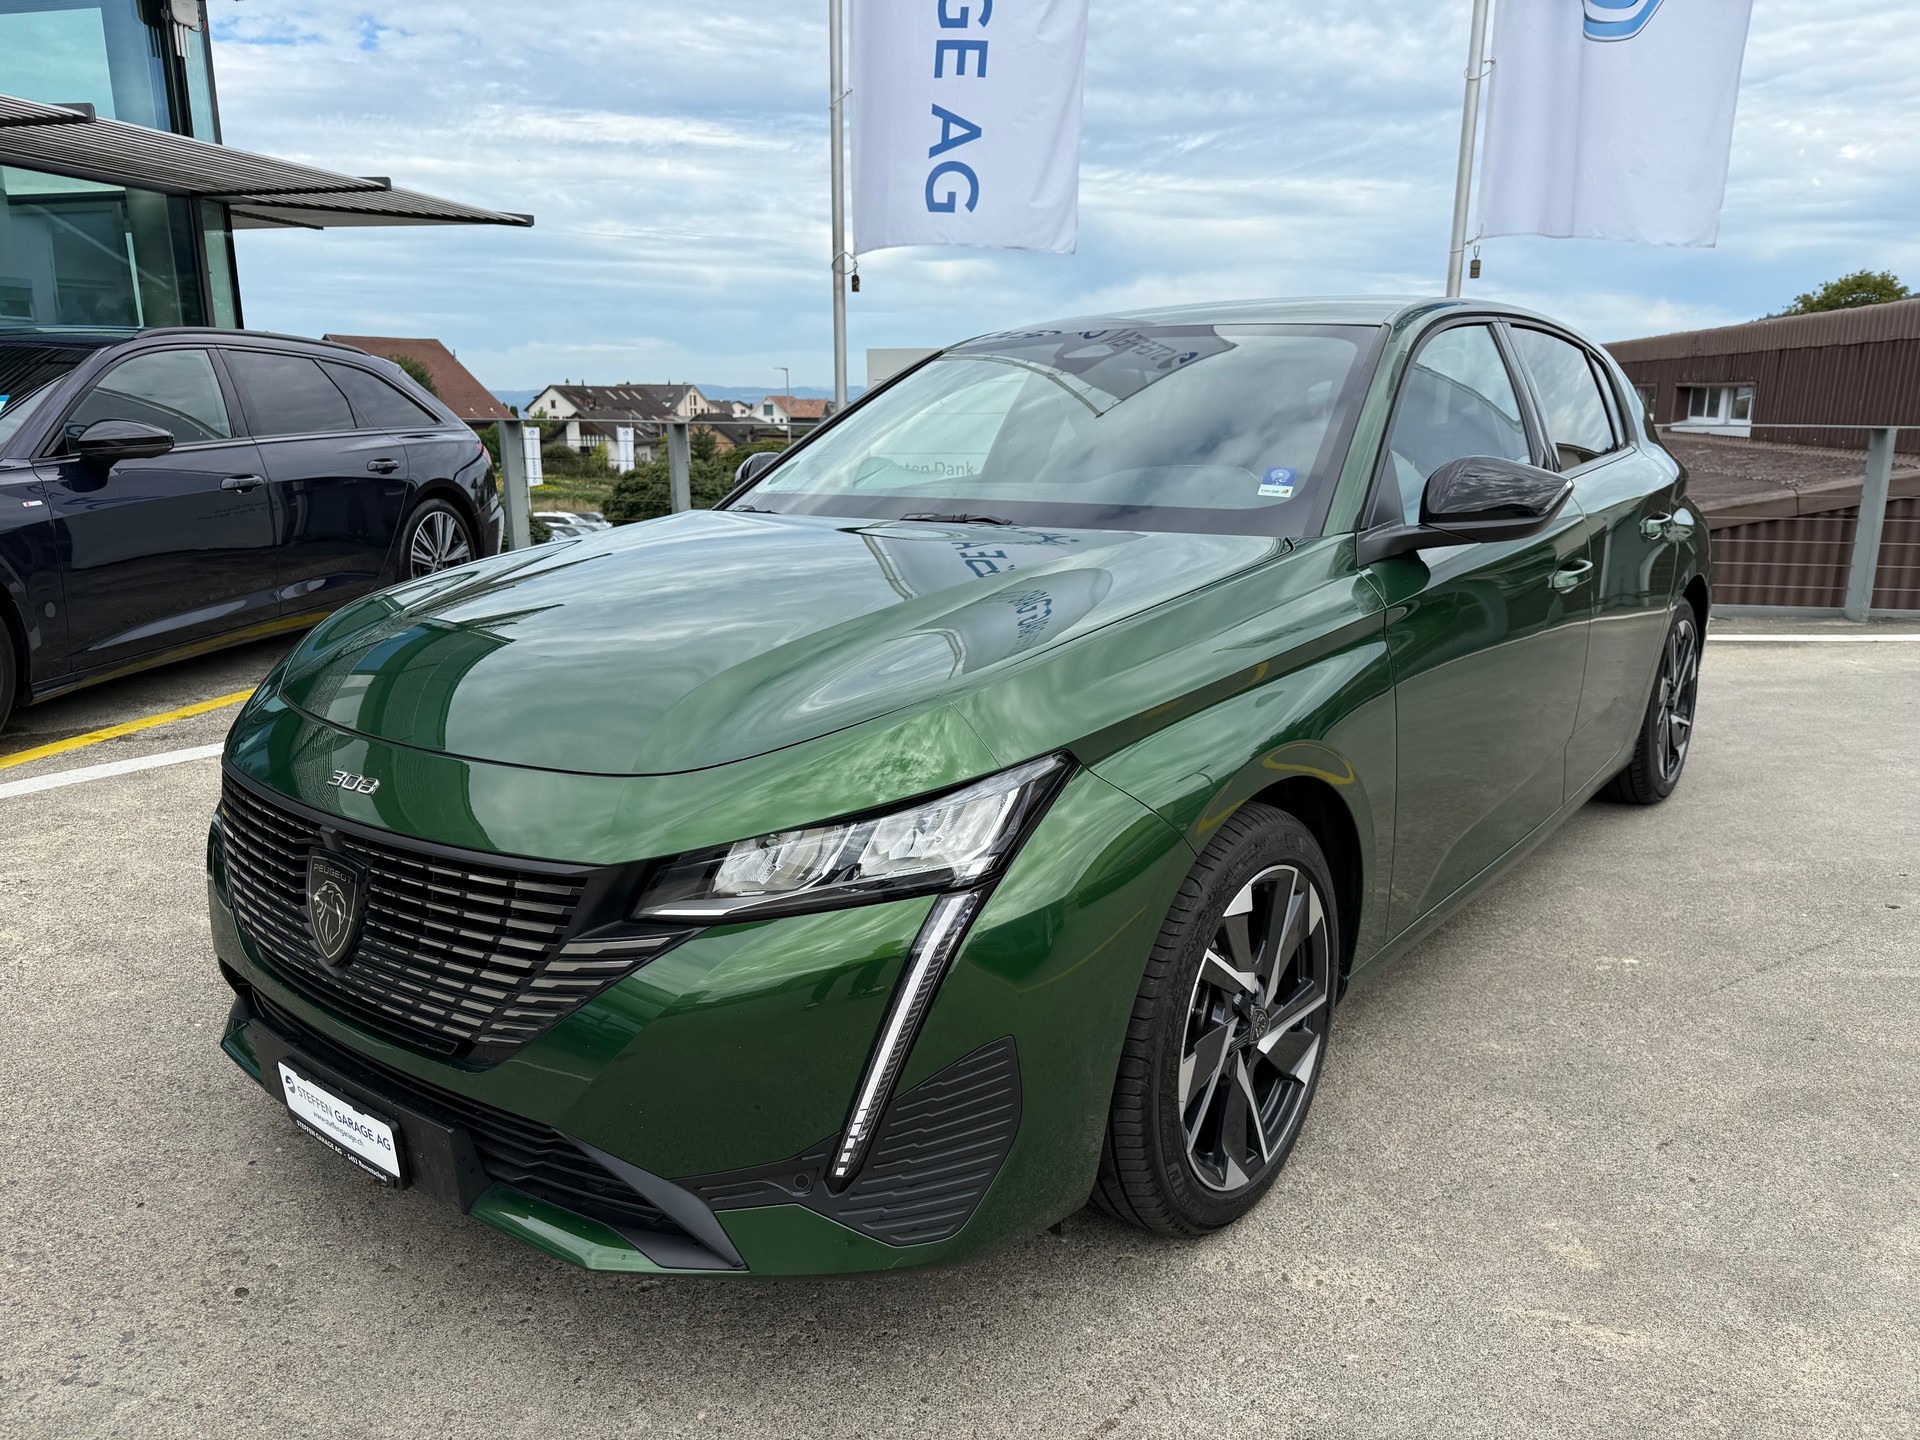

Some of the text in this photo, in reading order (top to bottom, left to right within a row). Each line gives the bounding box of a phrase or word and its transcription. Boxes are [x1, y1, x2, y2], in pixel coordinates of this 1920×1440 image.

[925, 103, 982, 213] AG
[934, 460, 974, 477] Dank
[327, 769, 380, 796] 308
[313, 864, 353, 885] PEUGEOT
[297, 1085, 391, 1151] STEFFEN GARAGE AG
